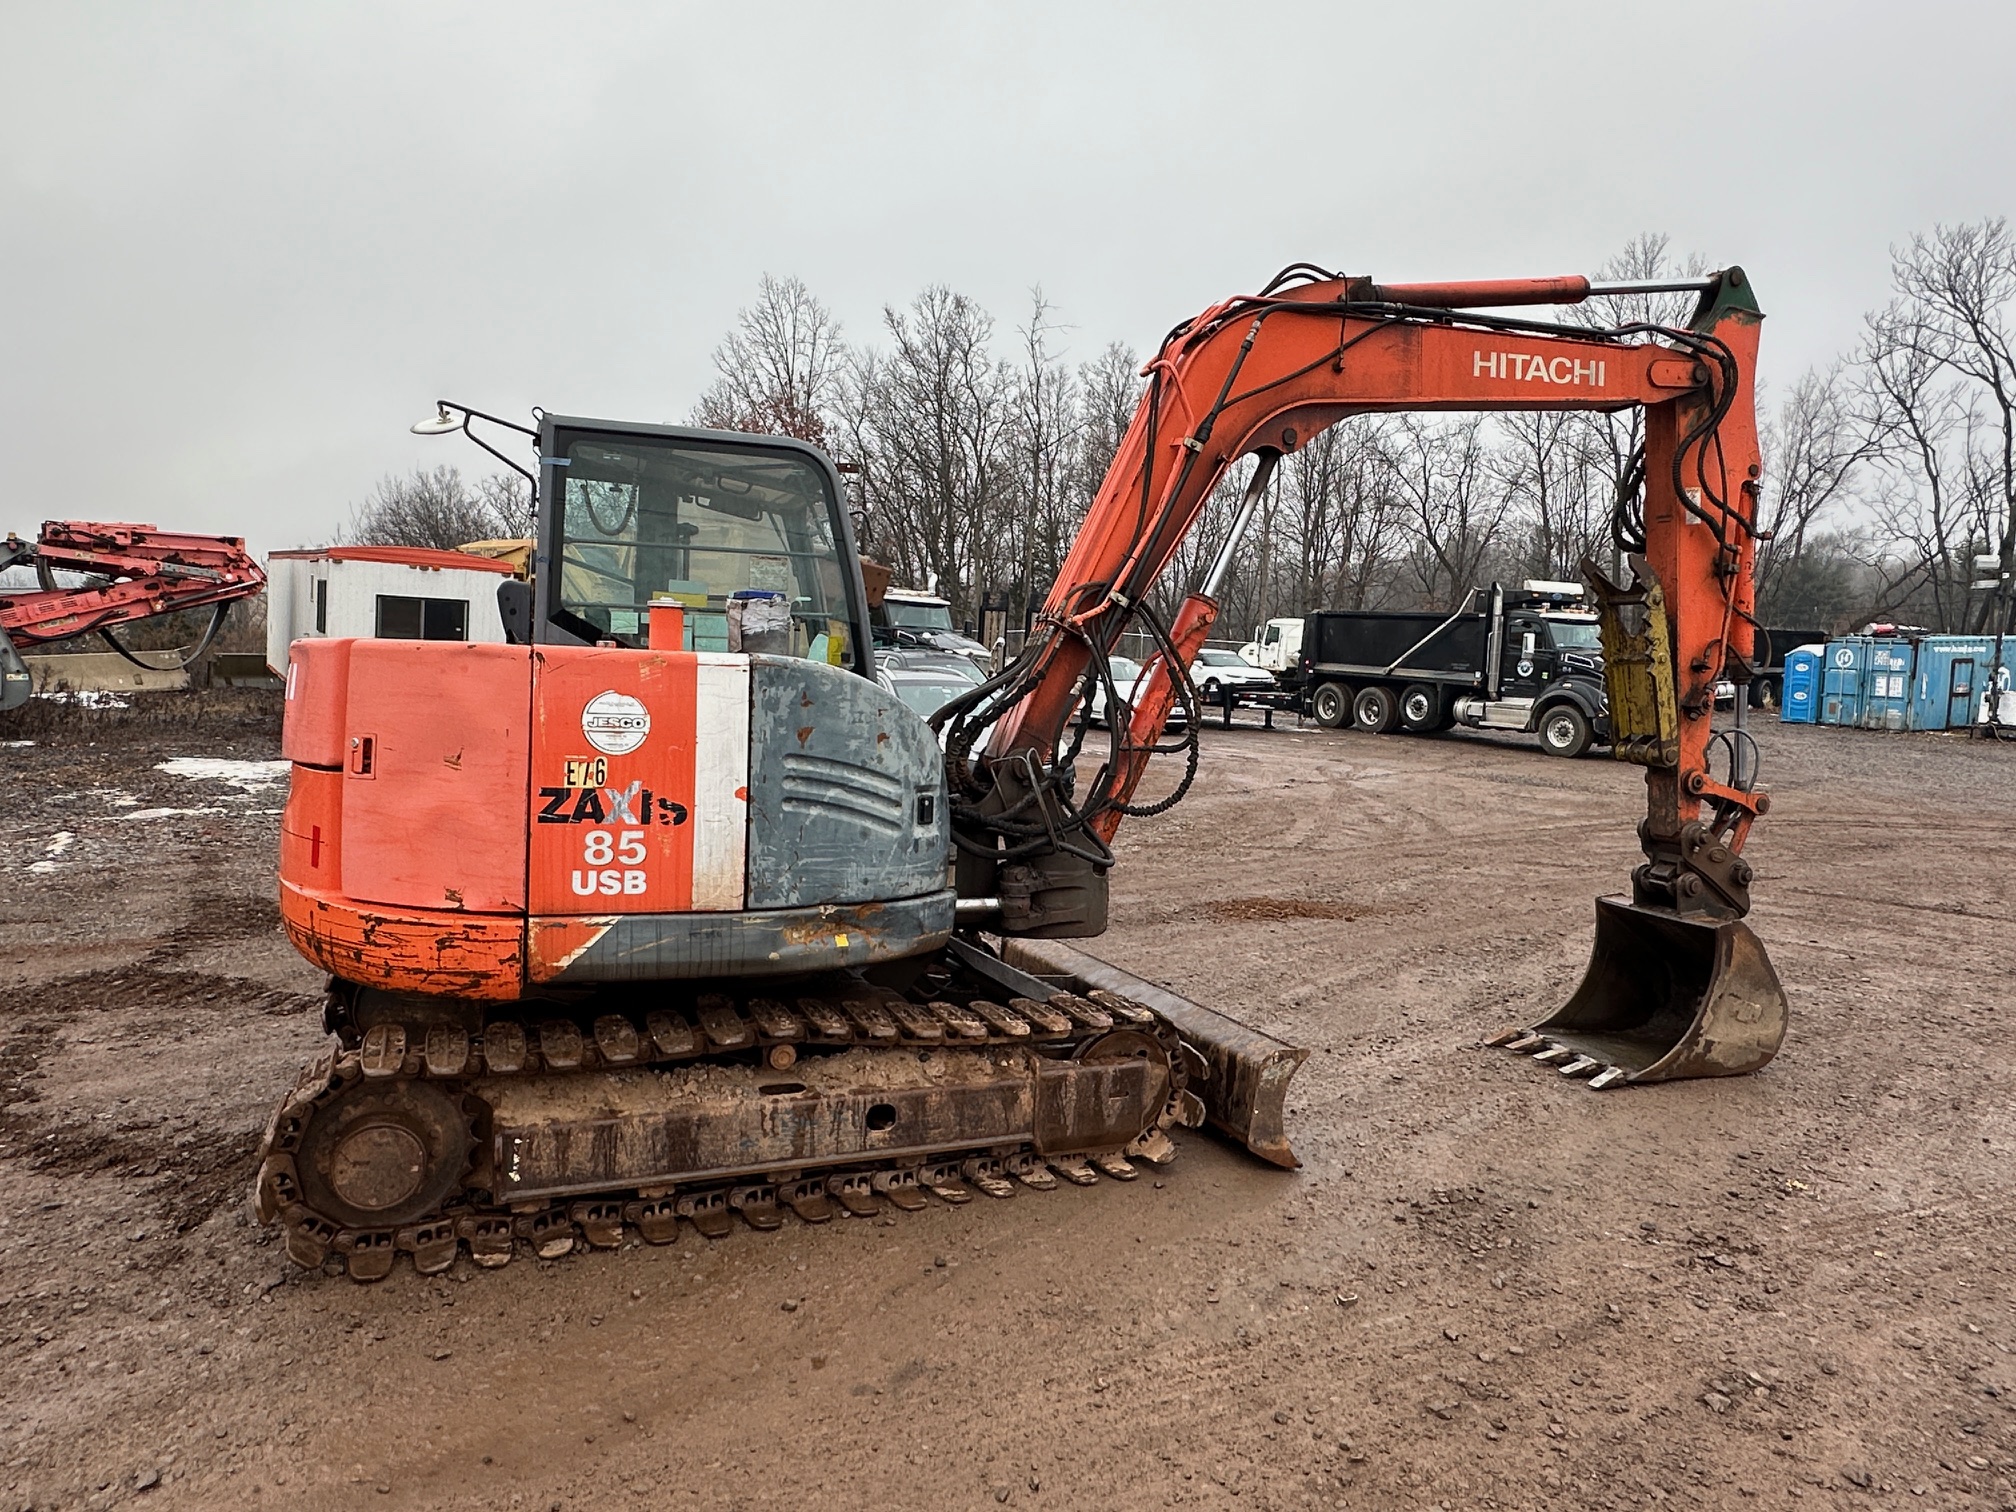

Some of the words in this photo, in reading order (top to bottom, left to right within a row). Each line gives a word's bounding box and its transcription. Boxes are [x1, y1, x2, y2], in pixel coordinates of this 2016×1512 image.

[1473, 350, 1605, 387] HITACHI
[587, 716, 646, 729] JESCO
[583, 830, 647, 866] 85
[571, 870, 647, 896] USB
